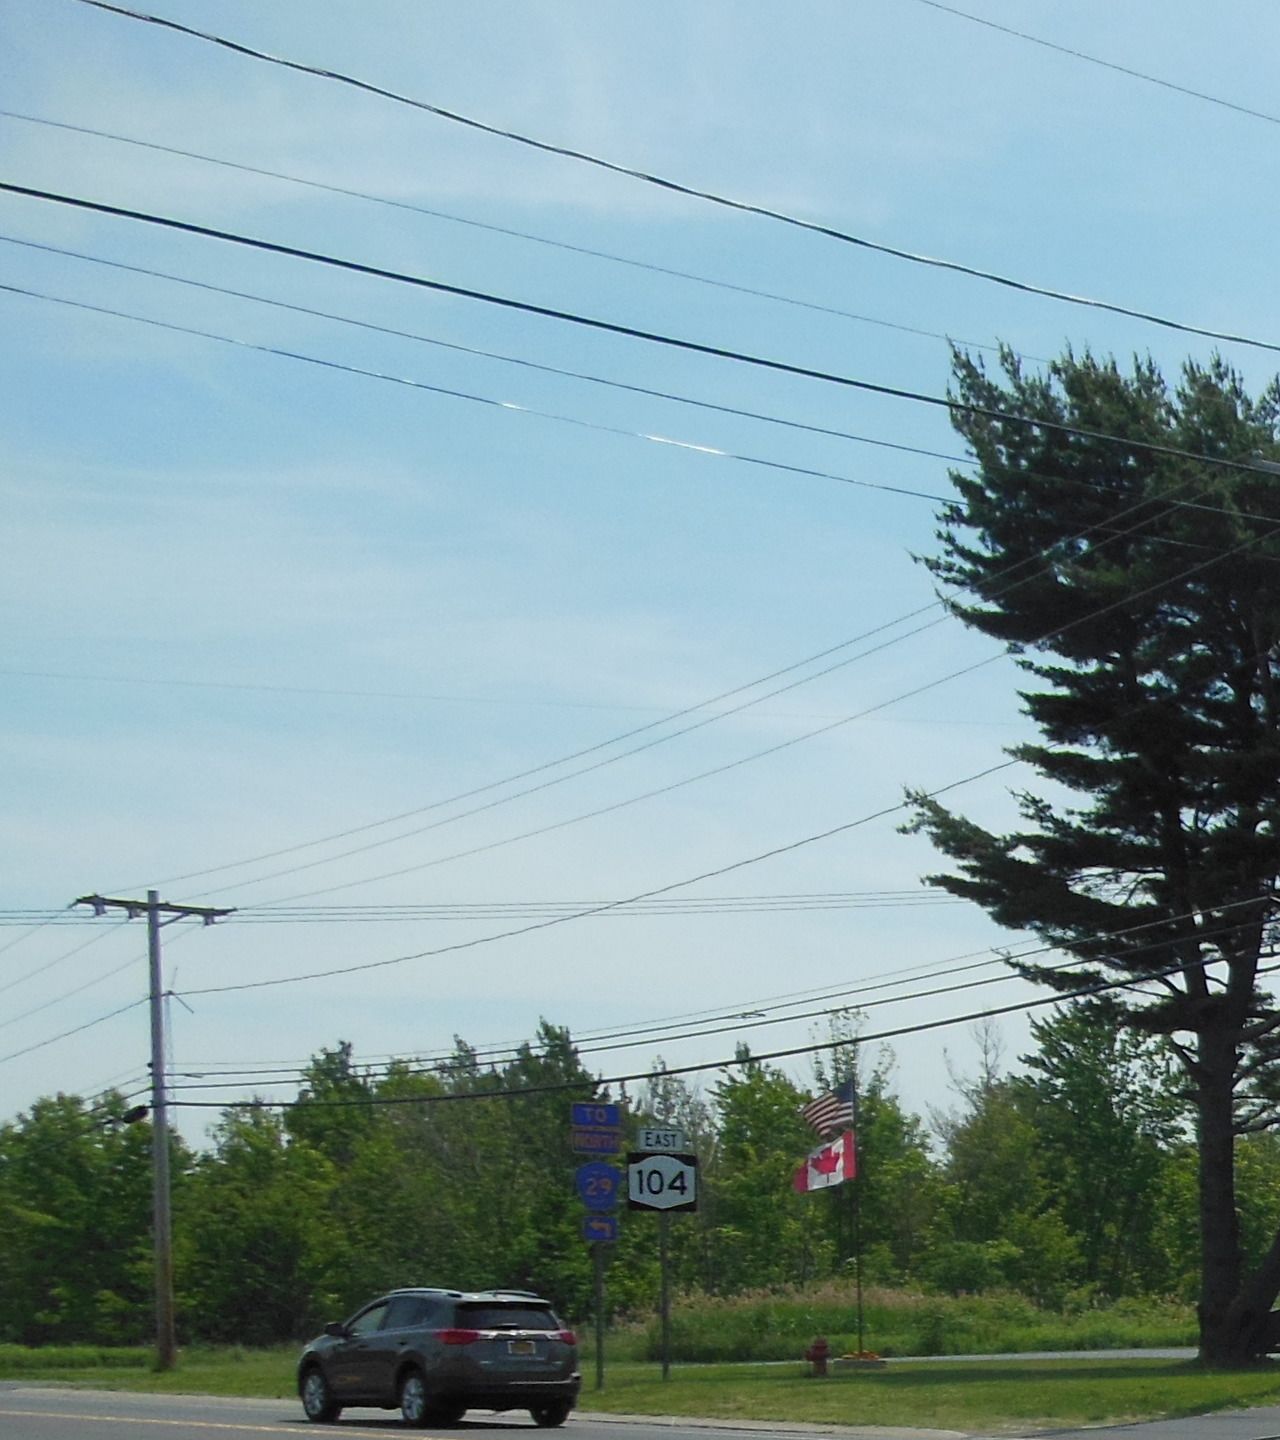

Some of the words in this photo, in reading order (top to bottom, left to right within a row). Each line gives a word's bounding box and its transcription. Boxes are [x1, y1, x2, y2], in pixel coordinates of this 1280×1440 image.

[582, 1107, 607, 1122] TO
[645, 1131, 678, 1148] EAST
[585, 1177, 613, 1196] 29
[637, 1169, 688, 1196] 104
